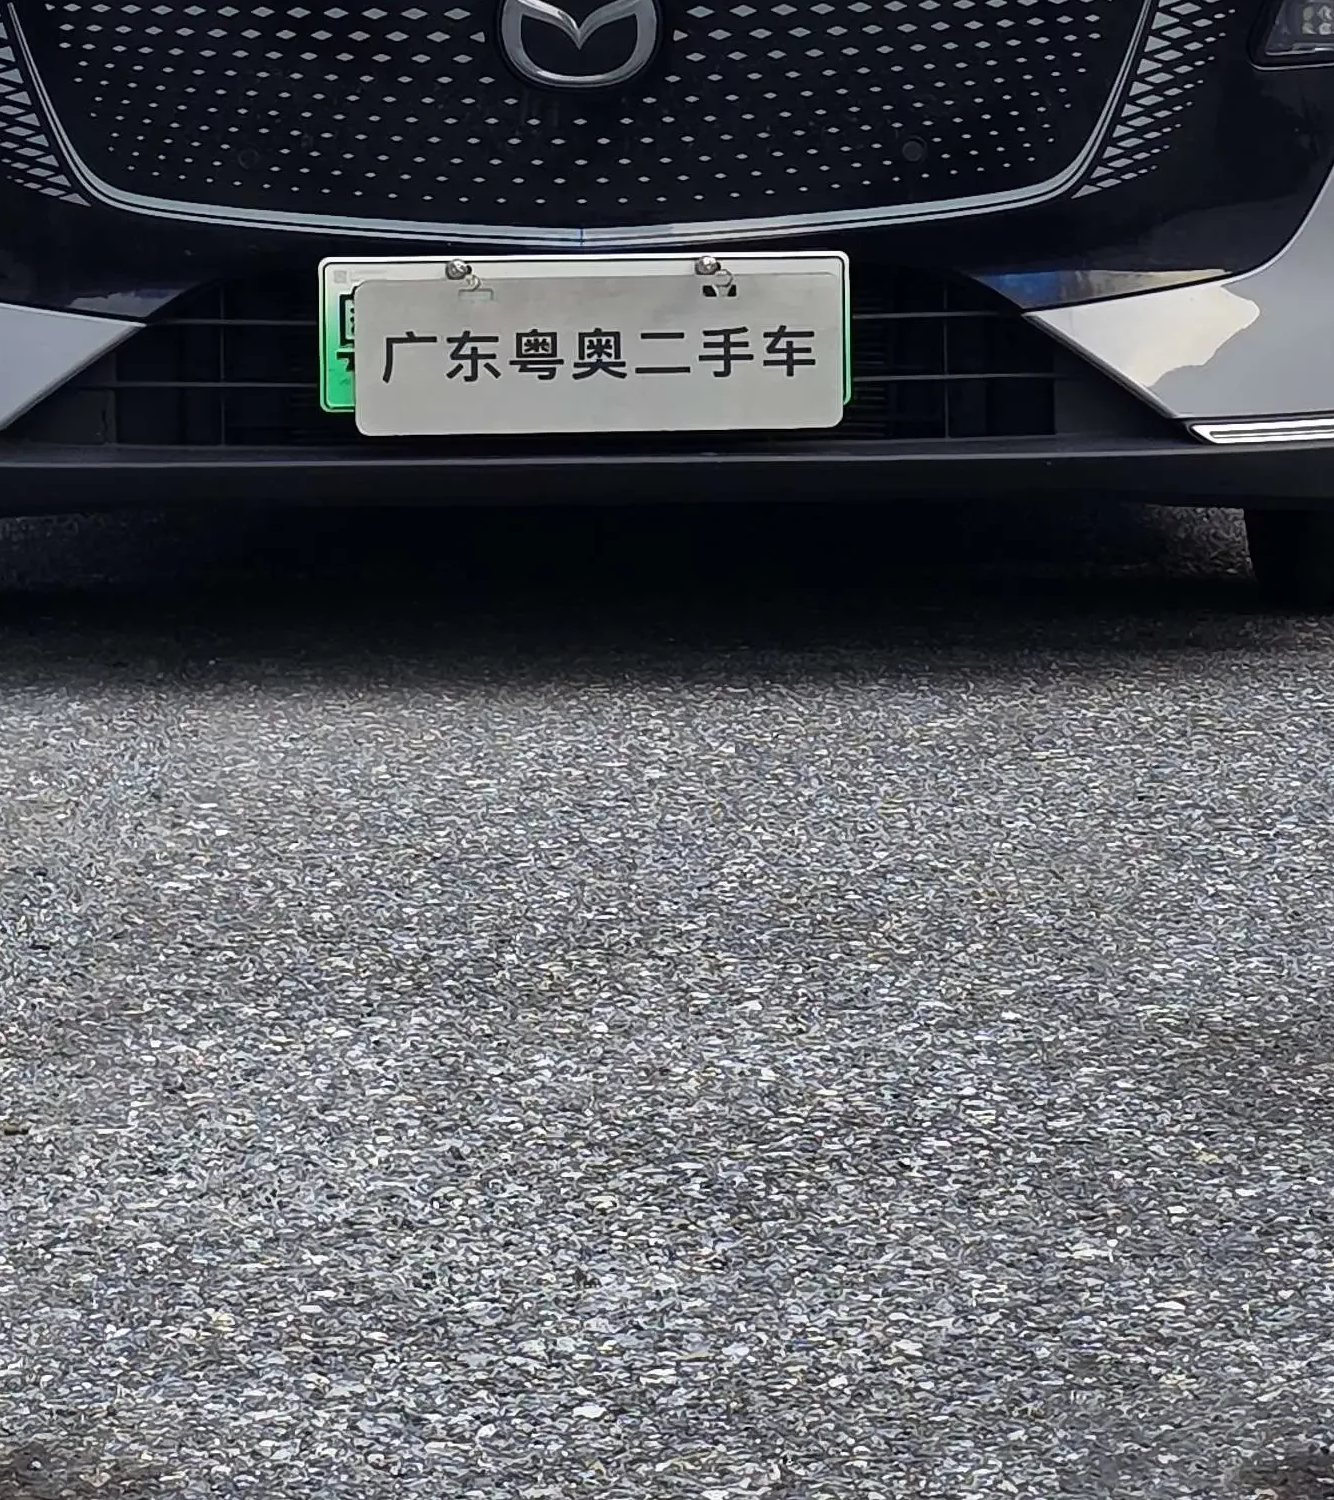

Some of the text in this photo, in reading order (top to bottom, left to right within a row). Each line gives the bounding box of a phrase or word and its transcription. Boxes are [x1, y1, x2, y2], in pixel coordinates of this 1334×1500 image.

[382, 328, 817, 383] 广东粤奥二手车
